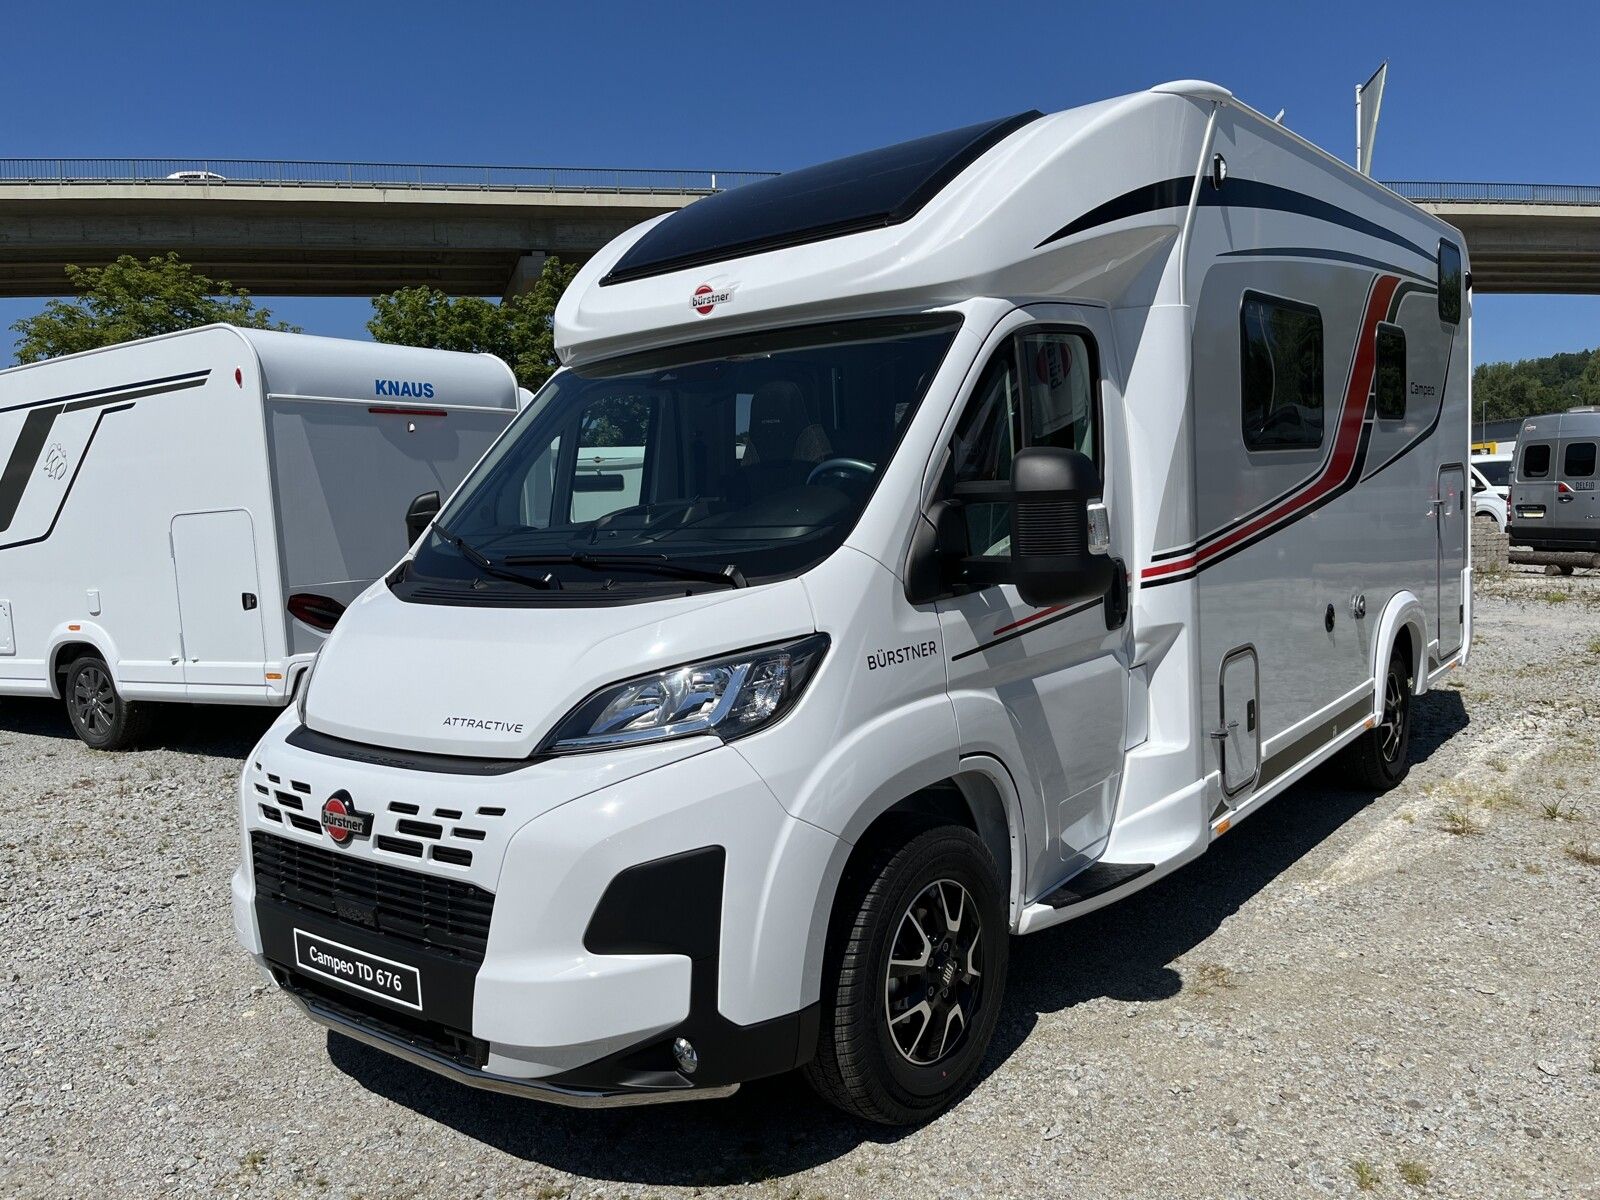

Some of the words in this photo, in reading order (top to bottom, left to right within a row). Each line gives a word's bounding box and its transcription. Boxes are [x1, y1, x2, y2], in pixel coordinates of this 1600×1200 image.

[692, 293, 729, 307] bürstner
[375, 379, 434, 398] KNAUS
[1410, 381, 1435, 398] Campeo
[867, 641, 937, 670] BÜRSTNER
[443, 717, 524, 733] ATTRACTIVE
[323, 811, 363, 832] bürstner
[309, 945, 354, 975] Campeo
[355, 961, 373, 981] TD
[376, 969, 402, 992] 676
